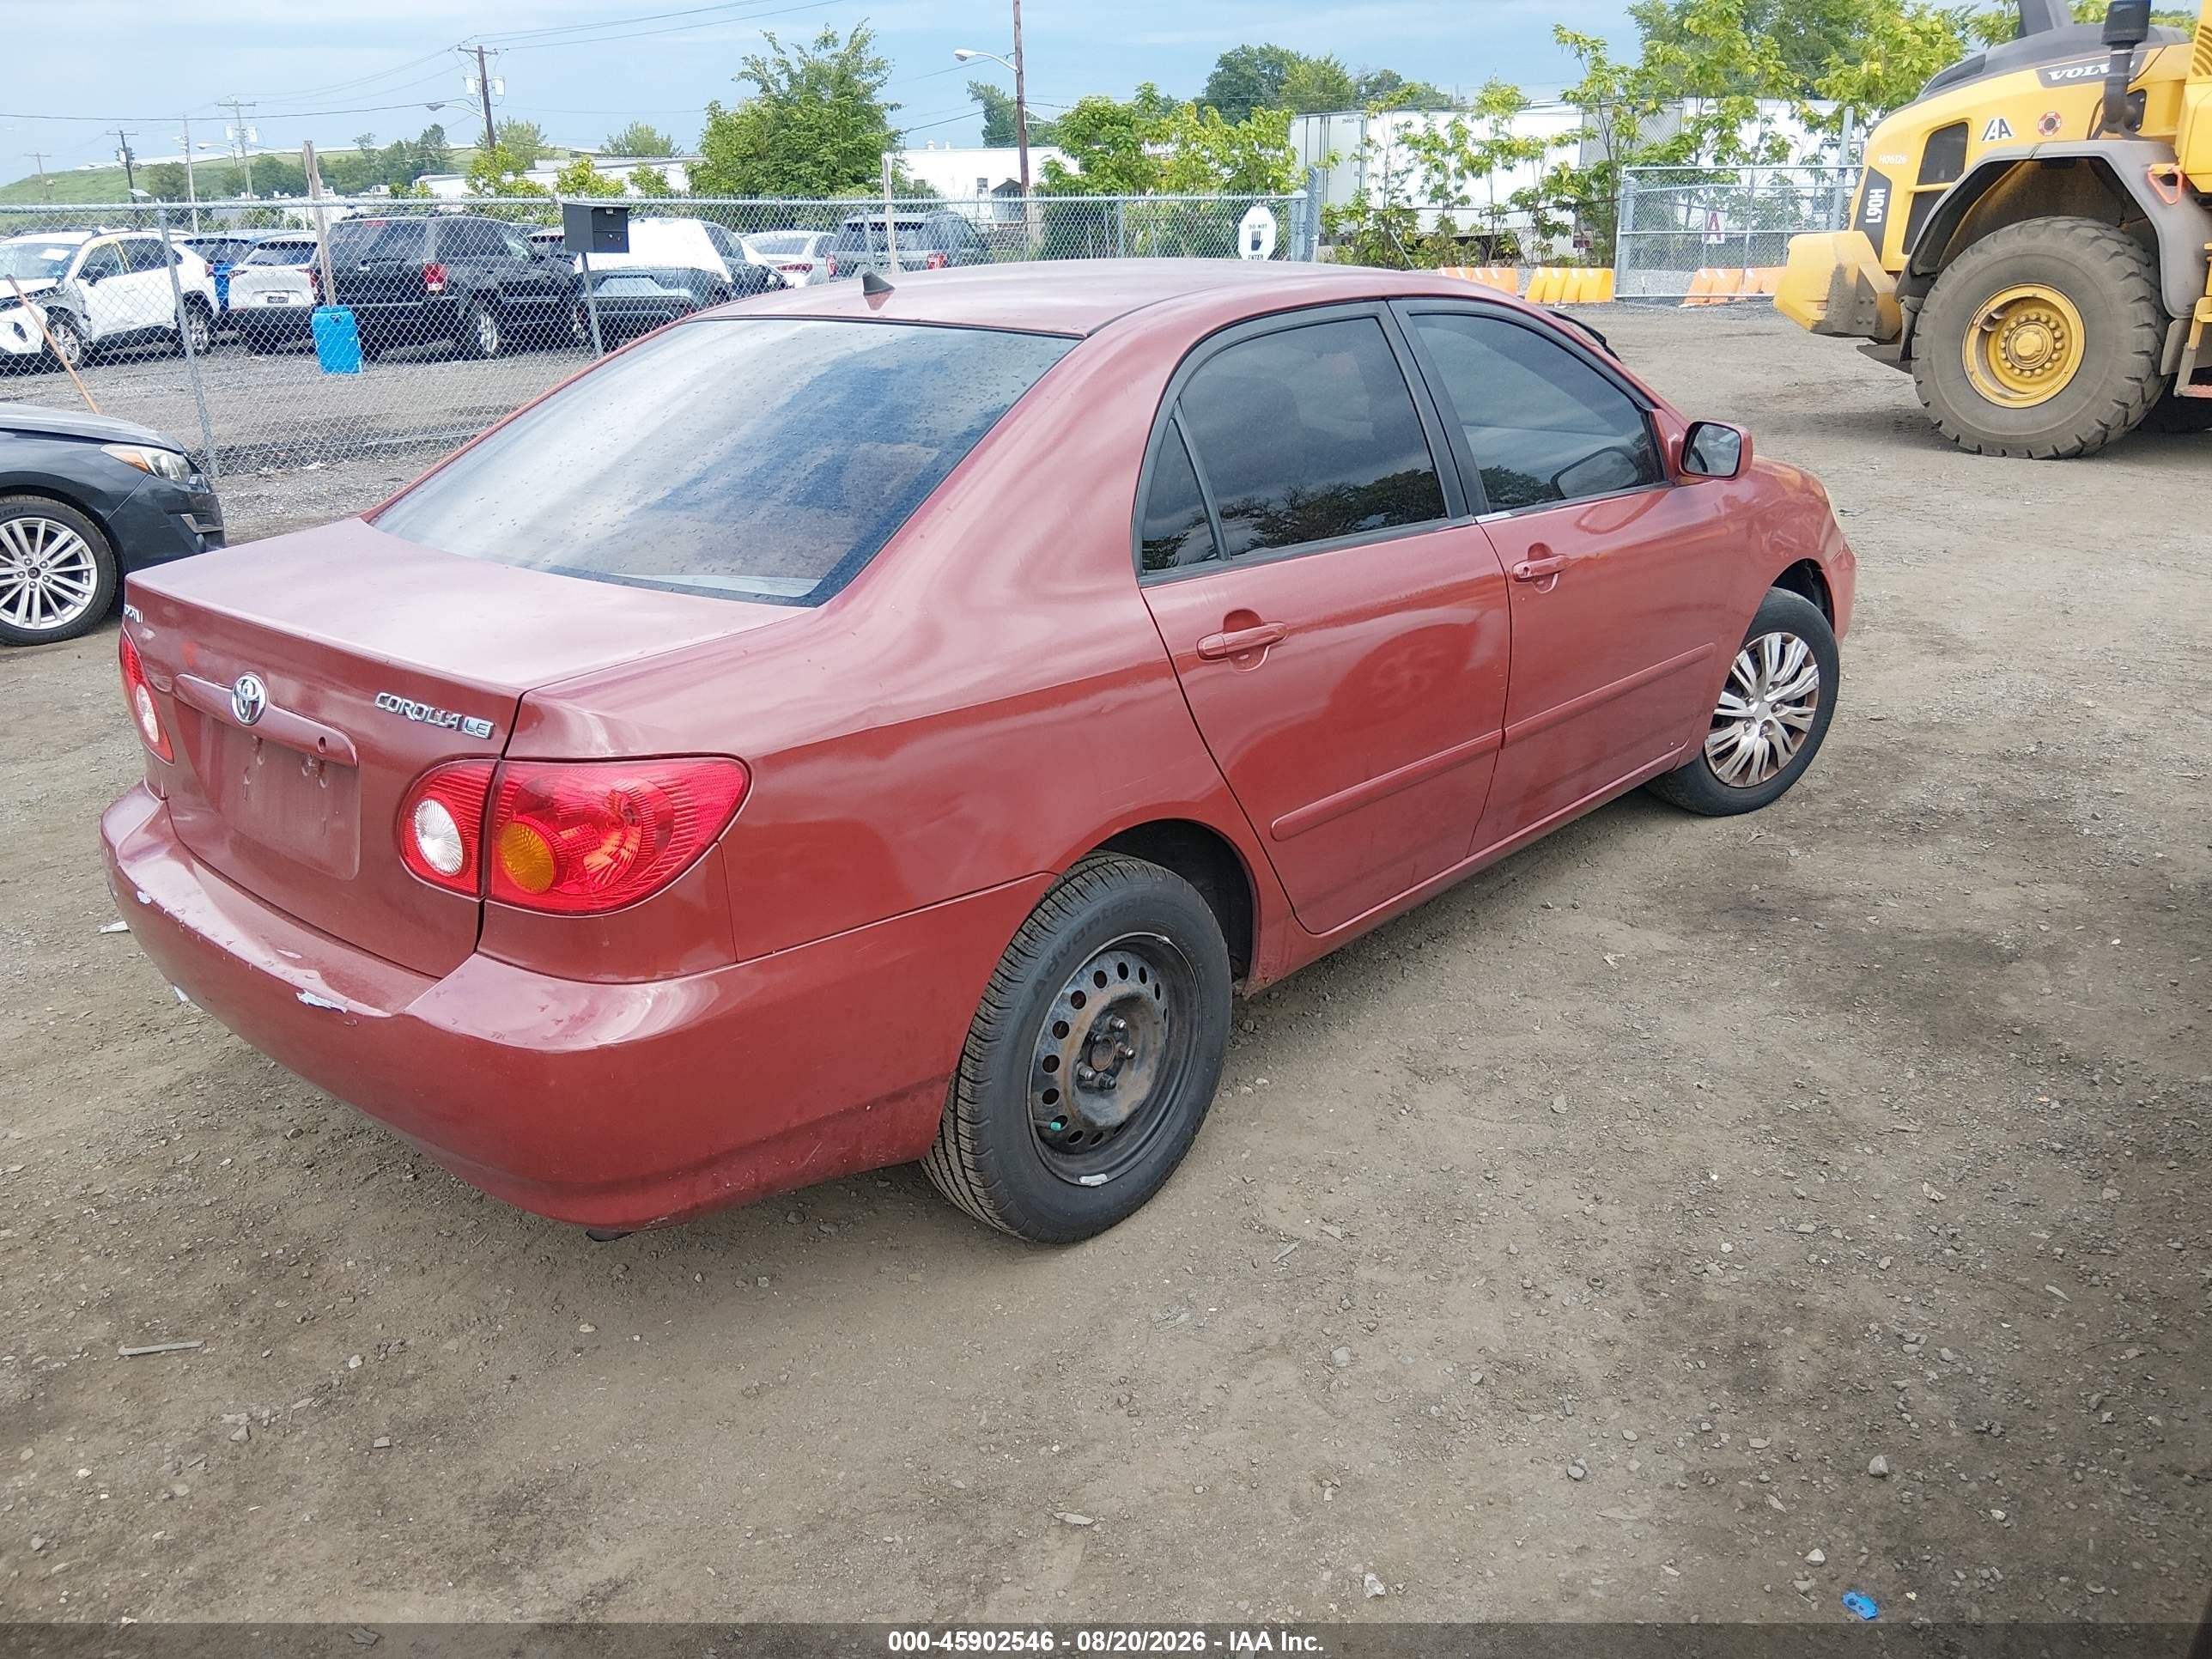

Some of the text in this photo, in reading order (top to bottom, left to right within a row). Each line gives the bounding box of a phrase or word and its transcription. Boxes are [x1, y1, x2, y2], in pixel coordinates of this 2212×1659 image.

[2047, 60, 2135, 81] VOLV
[1865, 188, 1887, 223] L90H
[1703, 211, 1722, 241] A
[374, 692, 495, 739] COROLLA LE
